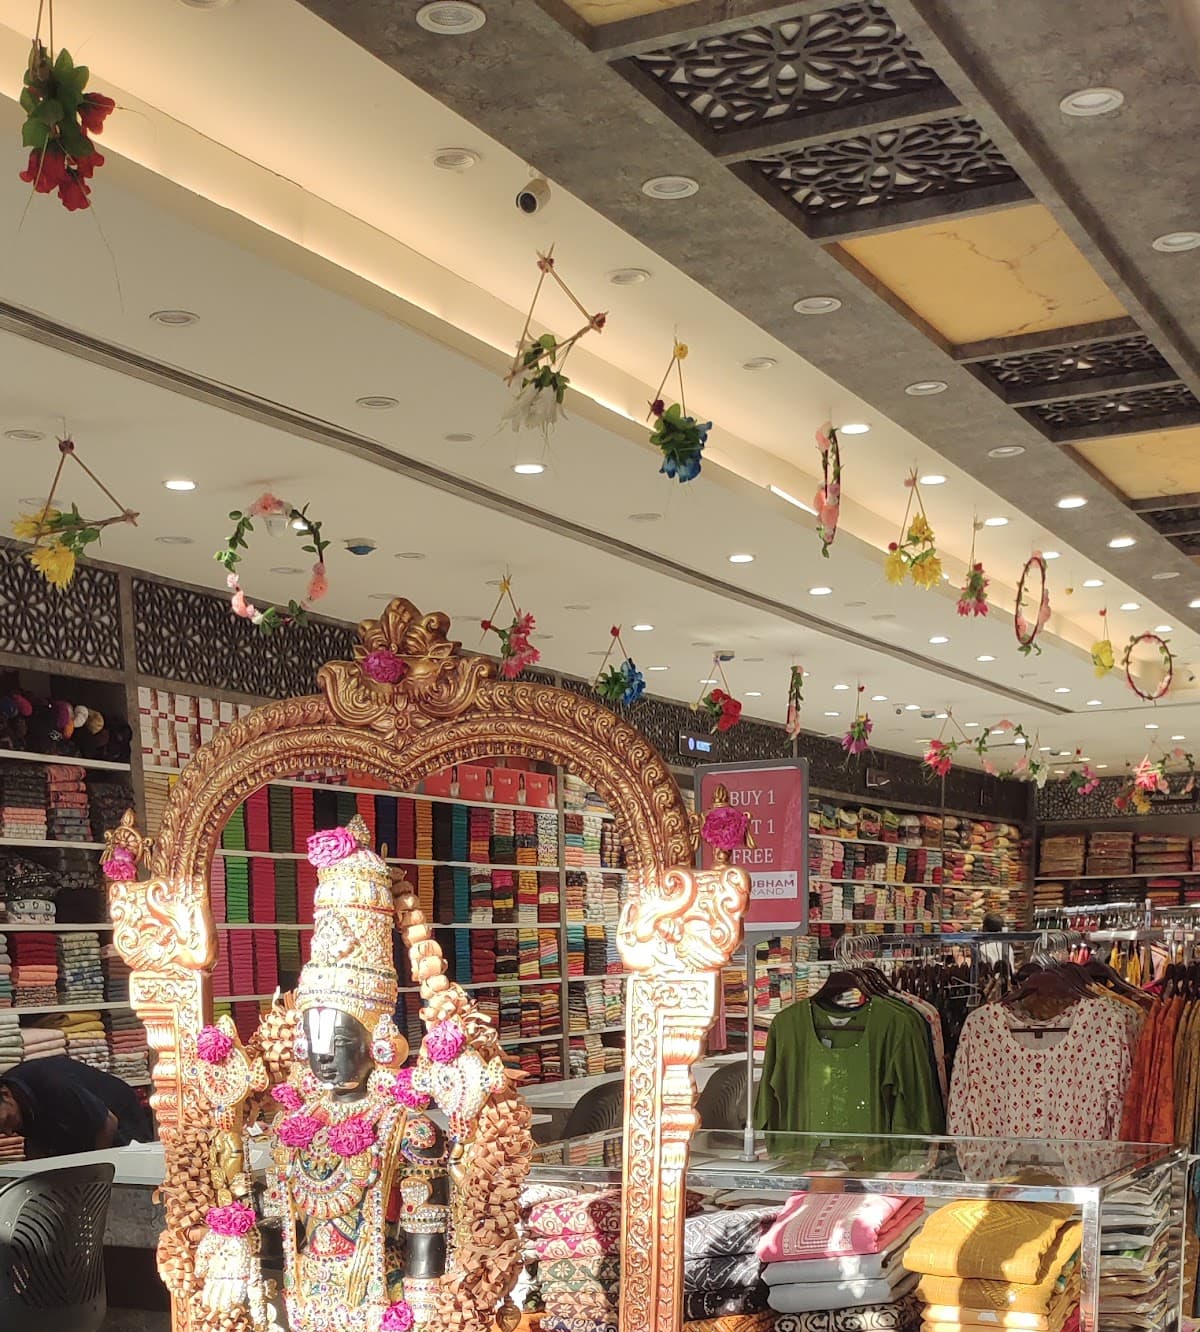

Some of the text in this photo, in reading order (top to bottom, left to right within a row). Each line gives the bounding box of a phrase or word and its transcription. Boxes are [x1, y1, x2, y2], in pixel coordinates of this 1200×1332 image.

[730, 789, 776, 807] BUY 1
[768, 819, 775, 834] 1
[732, 848, 774, 864] FREE
